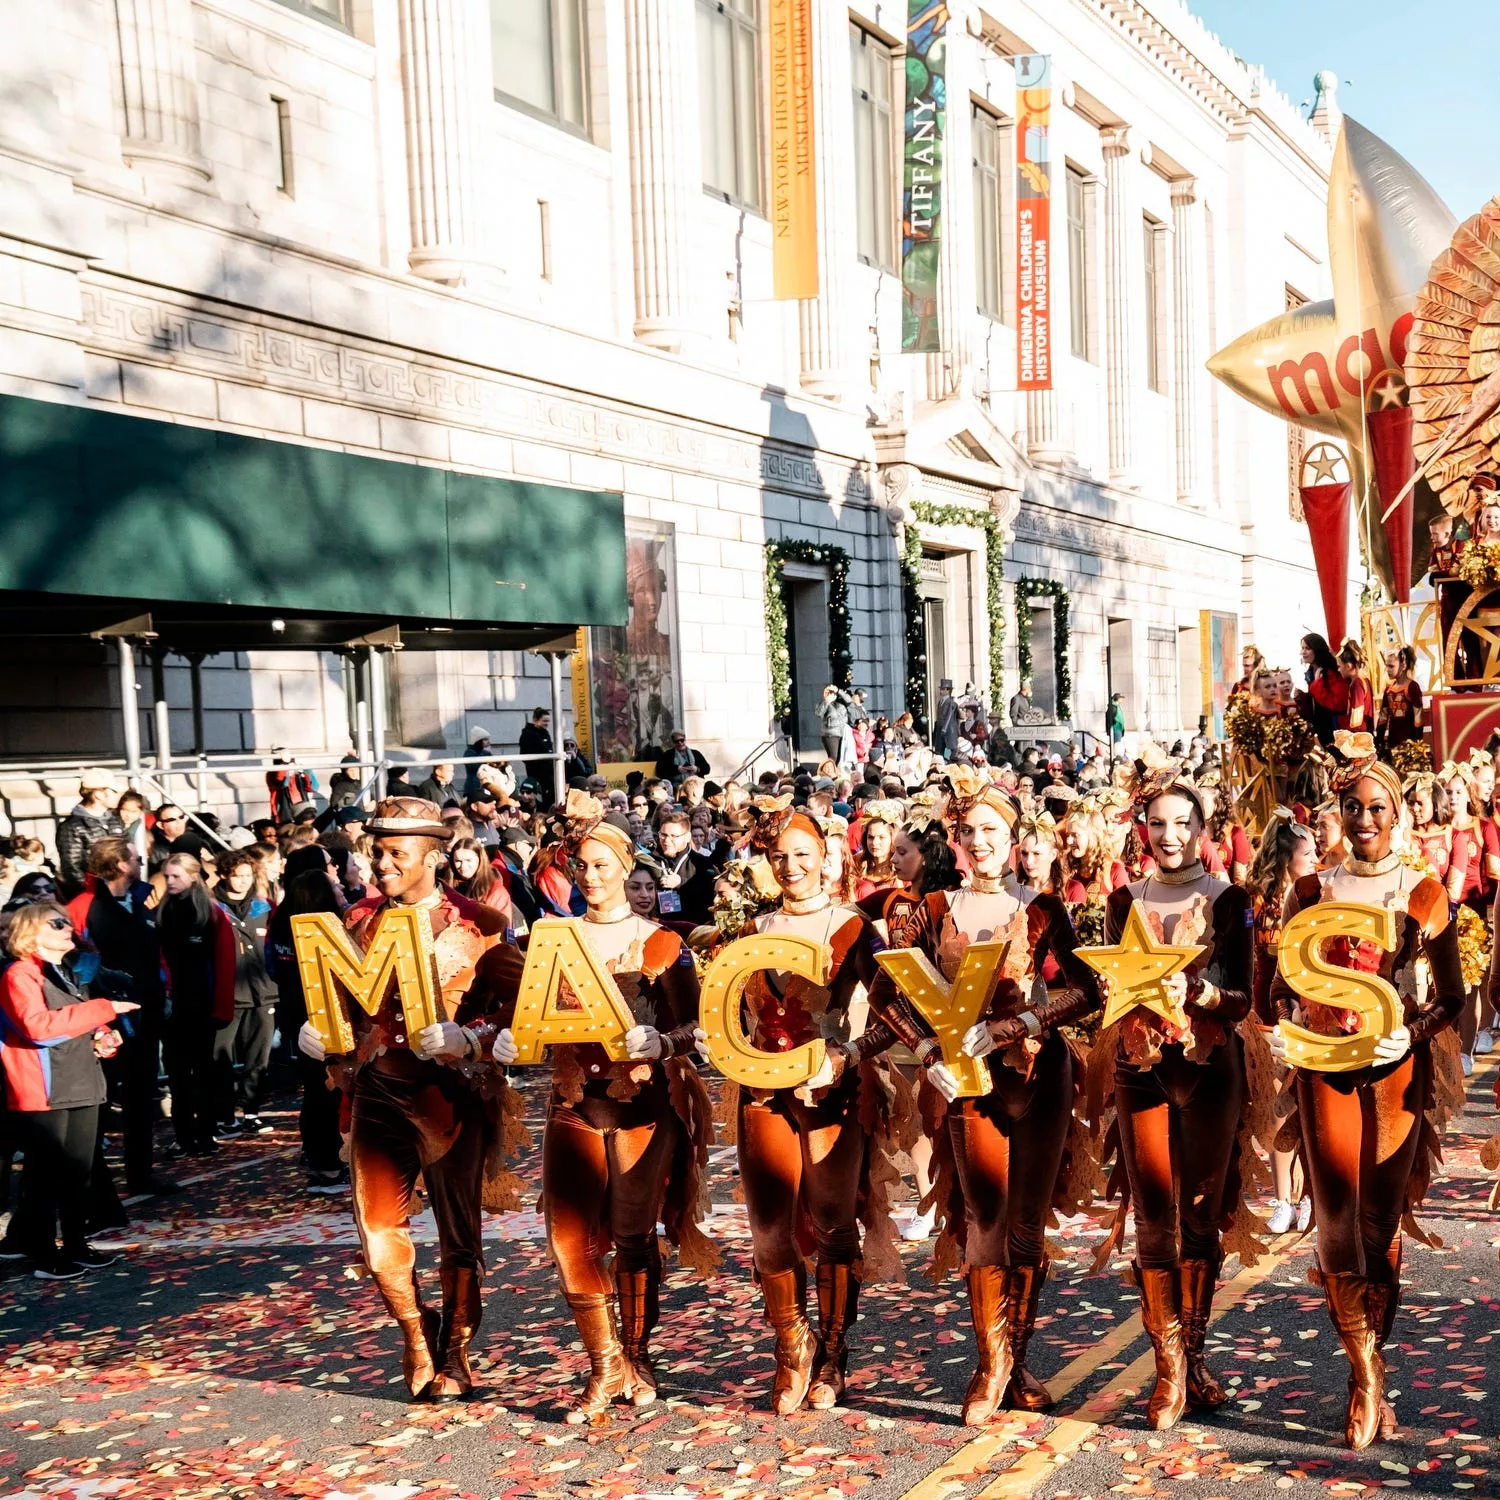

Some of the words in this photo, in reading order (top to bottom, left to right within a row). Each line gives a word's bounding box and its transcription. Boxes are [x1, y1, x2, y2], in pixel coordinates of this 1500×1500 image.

[773, 16, 788, 131] HISTORICAL
[794, 89, 810, 177] MUSEUM
[910, 97, 936, 234] TIFFANY
[775, 139, 791, 238] NEW-YORK
[1020, 208, 1034, 301] CHILDREN'S
[1034, 239, 1048, 311] MUSEUM
[1020, 303, 1034, 382] DIMENNA
[1034, 313, 1048, 382] HISTORY
